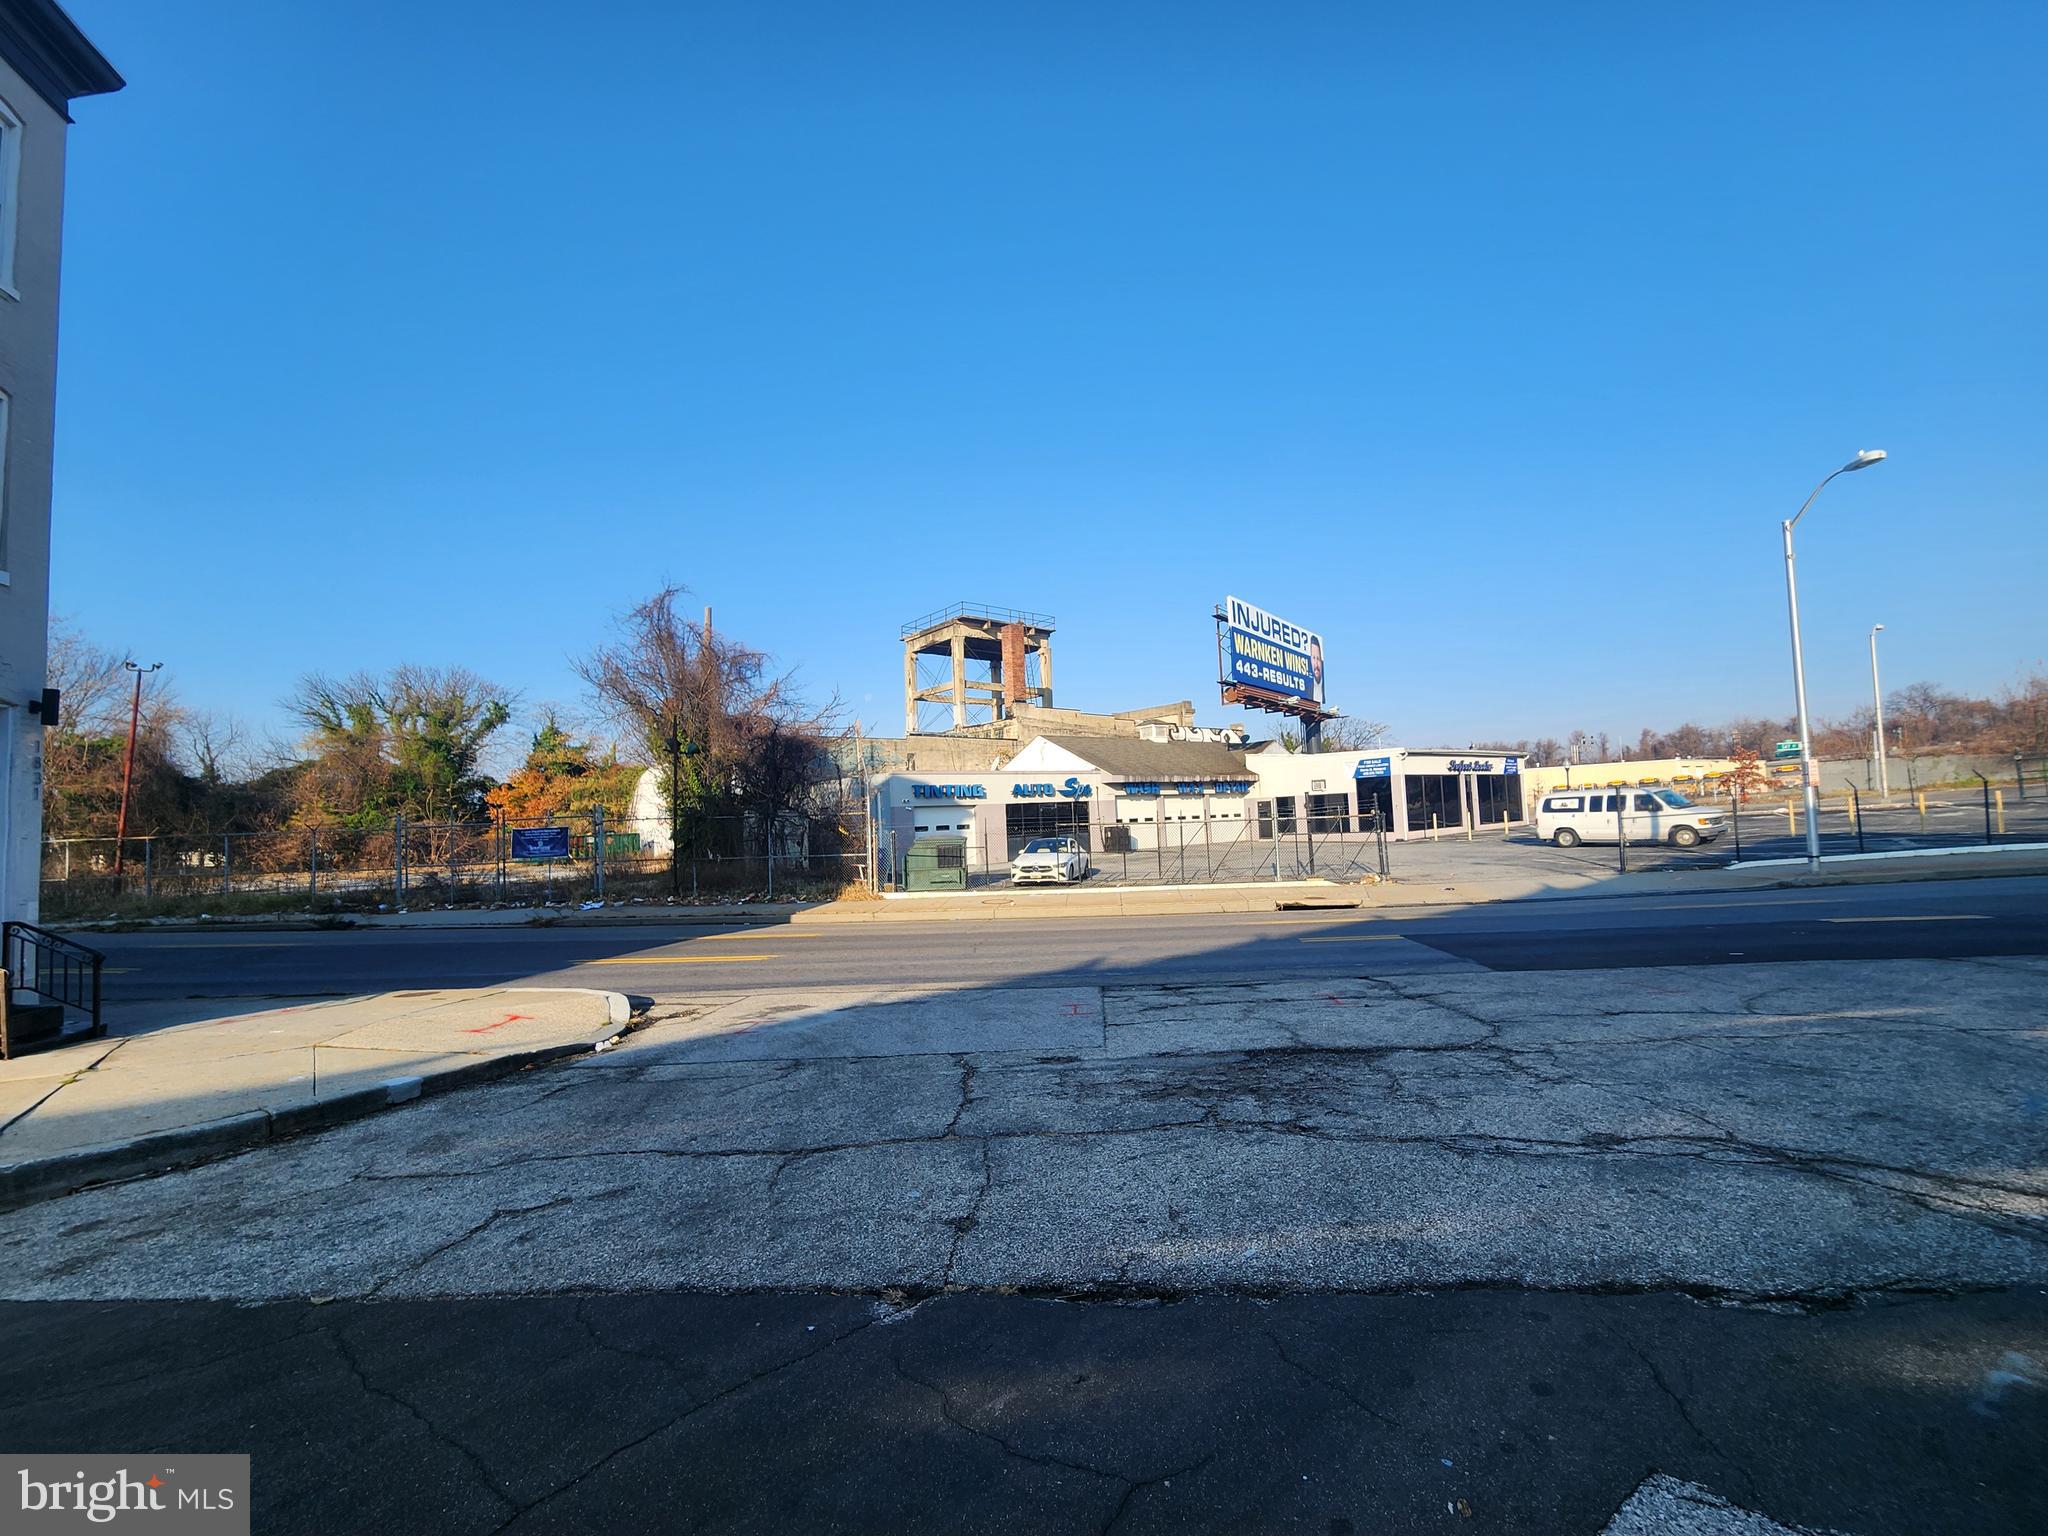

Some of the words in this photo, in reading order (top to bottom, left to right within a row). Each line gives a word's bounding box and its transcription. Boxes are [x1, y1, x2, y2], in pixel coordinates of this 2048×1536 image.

[1232, 600, 1308, 651] INJURED?
[1234, 632, 1283, 668] WARNKEN
[1284, 653, 1309, 677] WINS!
[1236, 659, 1306, 692] 443-RESULTS
[912, 783, 987, 799] TINTING
[1012, 783, 1056, 798] AUTO
[1056, 777, 1093, 800] Spa
[1124, 782, 1161, 795] WASH
